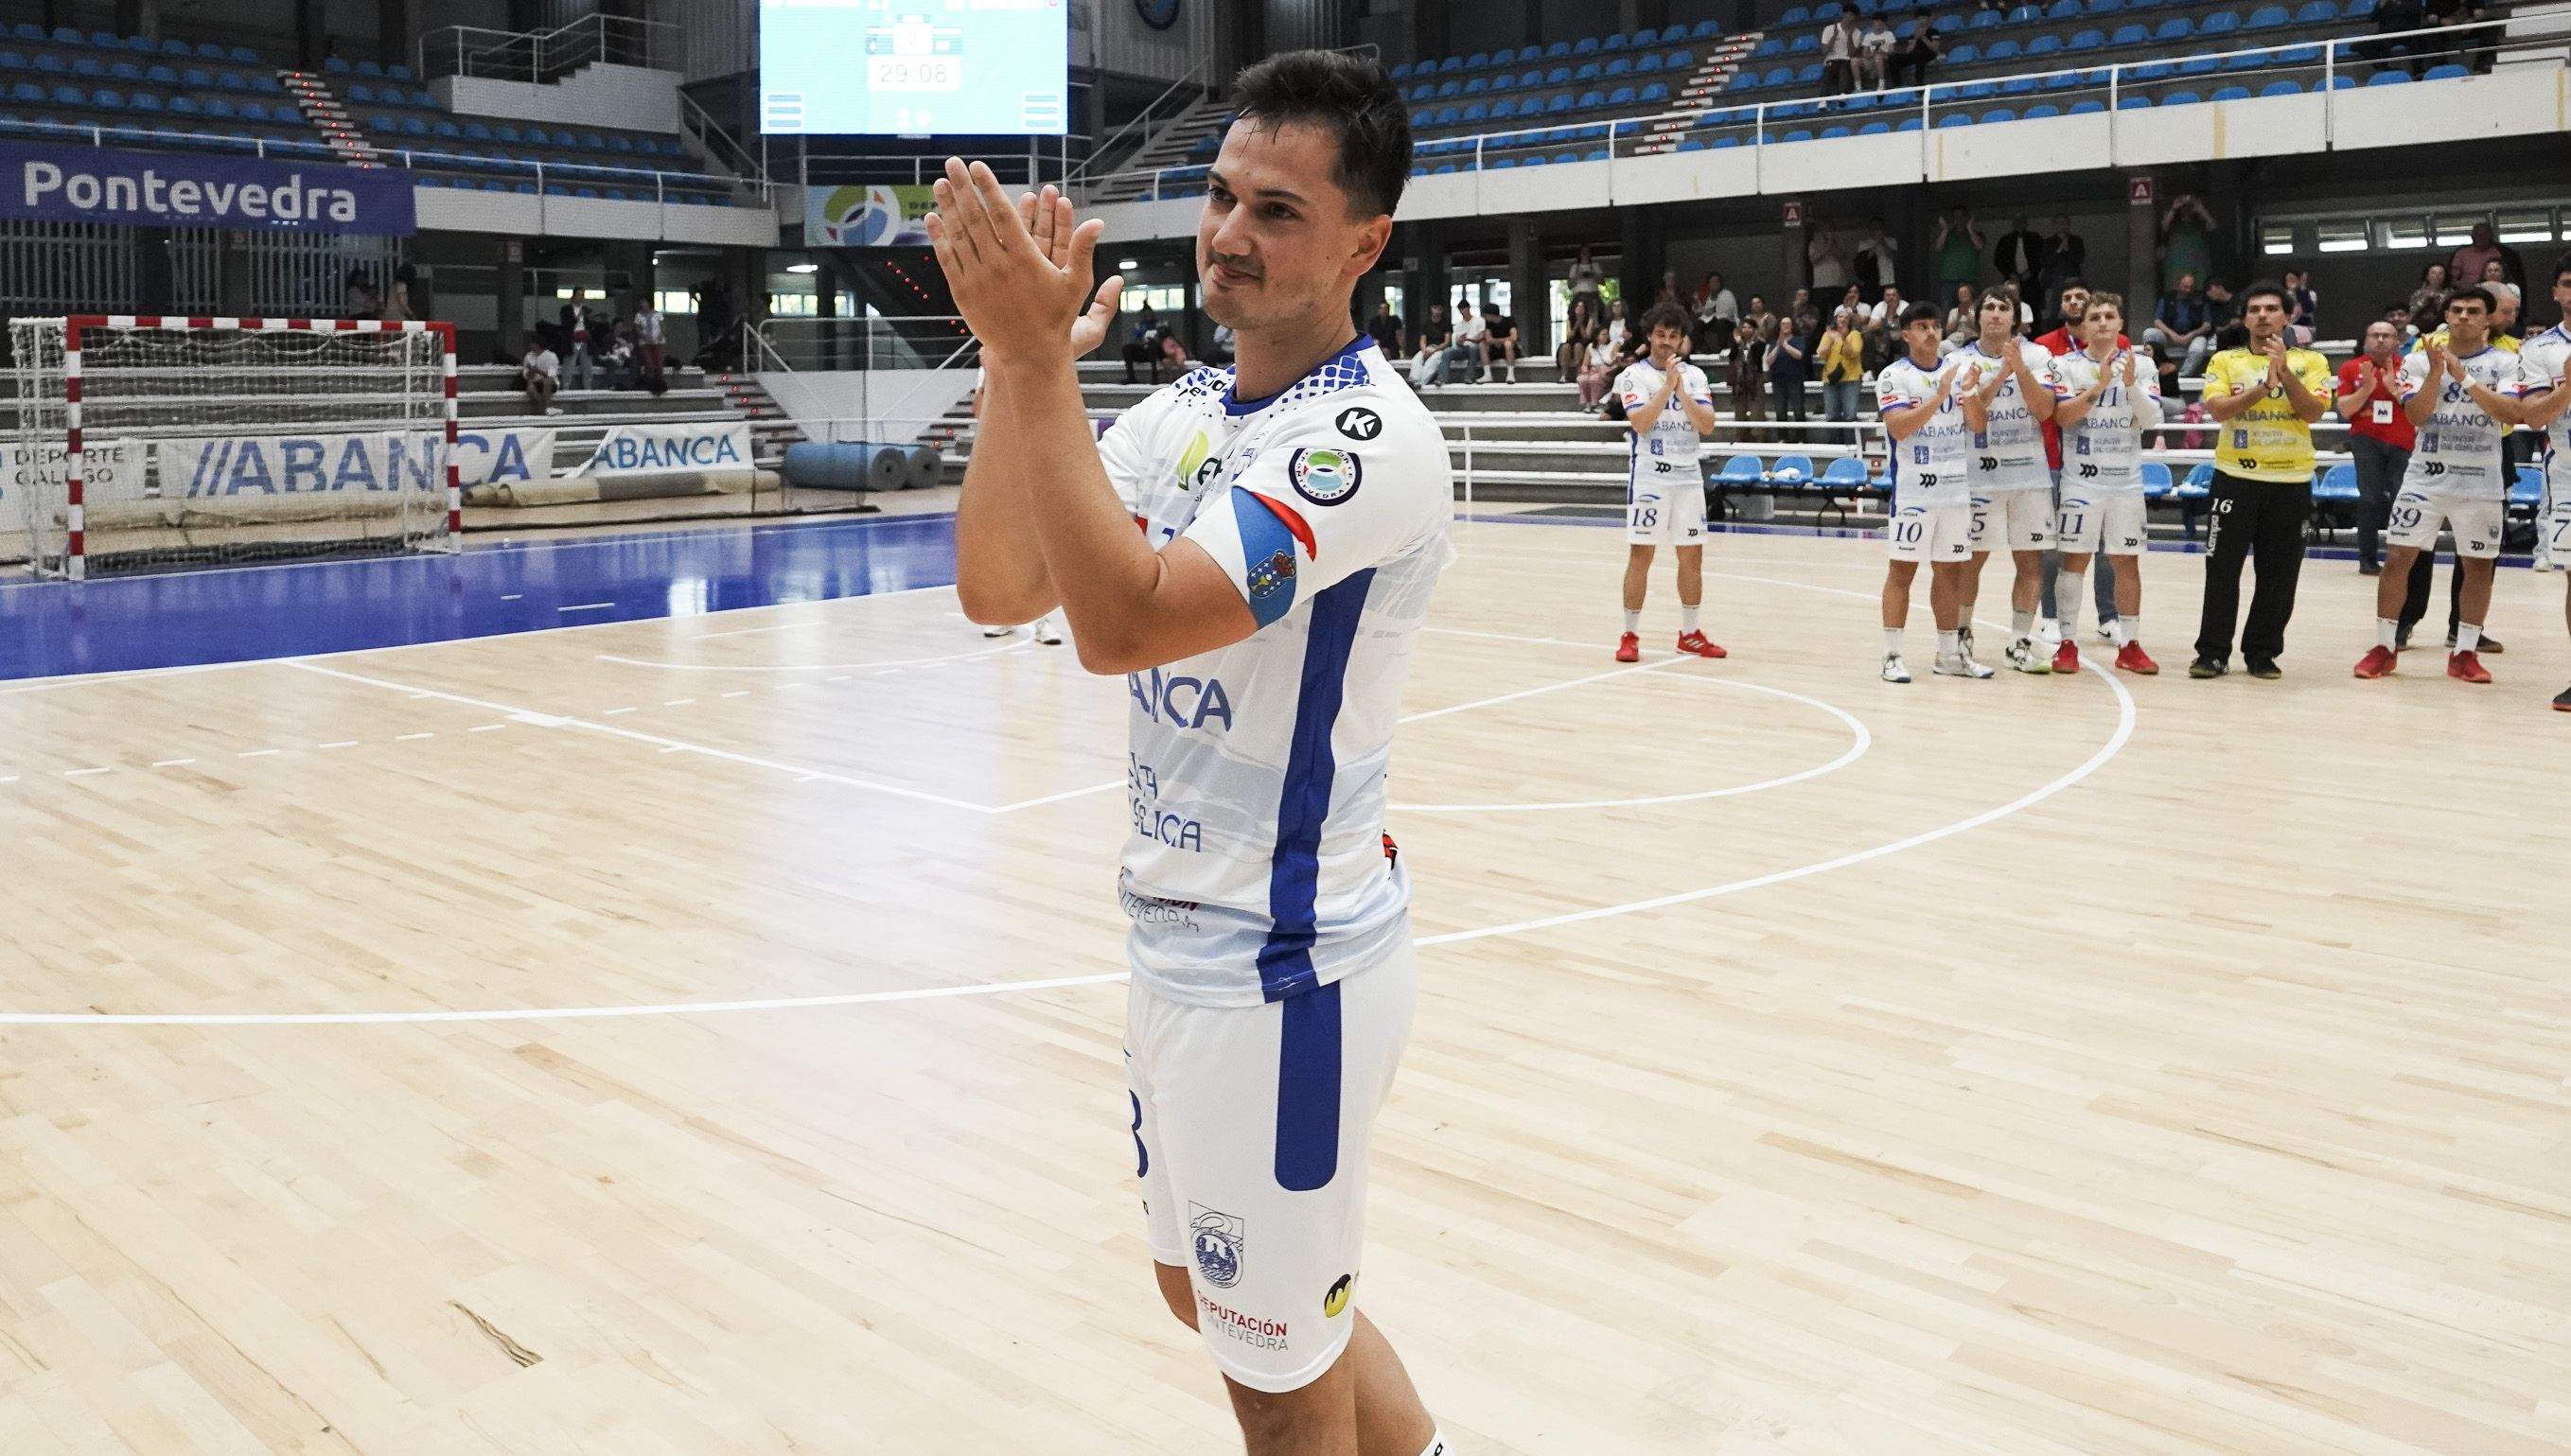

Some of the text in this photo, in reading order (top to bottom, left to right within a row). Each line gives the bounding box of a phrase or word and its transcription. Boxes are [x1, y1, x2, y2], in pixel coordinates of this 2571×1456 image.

[880, 63, 947, 83] 29:08
[24, 160, 357, 222] Pontevedra
[2096, 386, 2118, 407] 11
[1988, 407, 2030, 422] BANC
[2082, 417, 2134, 429] ABANC
[590, 433, 740, 469] ABANCA
[2210, 498, 2233, 514] 16
[1632, 508, 1658, 528] 18
[2059, 514, 2084, 535] 11
[1895, 521, 1923, 543] 10
[1128, 666, 1232, 732] ANCA
[1198, 1289, 1288, 1337] EPUTACIÓN
[1207, 1313, 1289, 1352] NTEVEDRA
